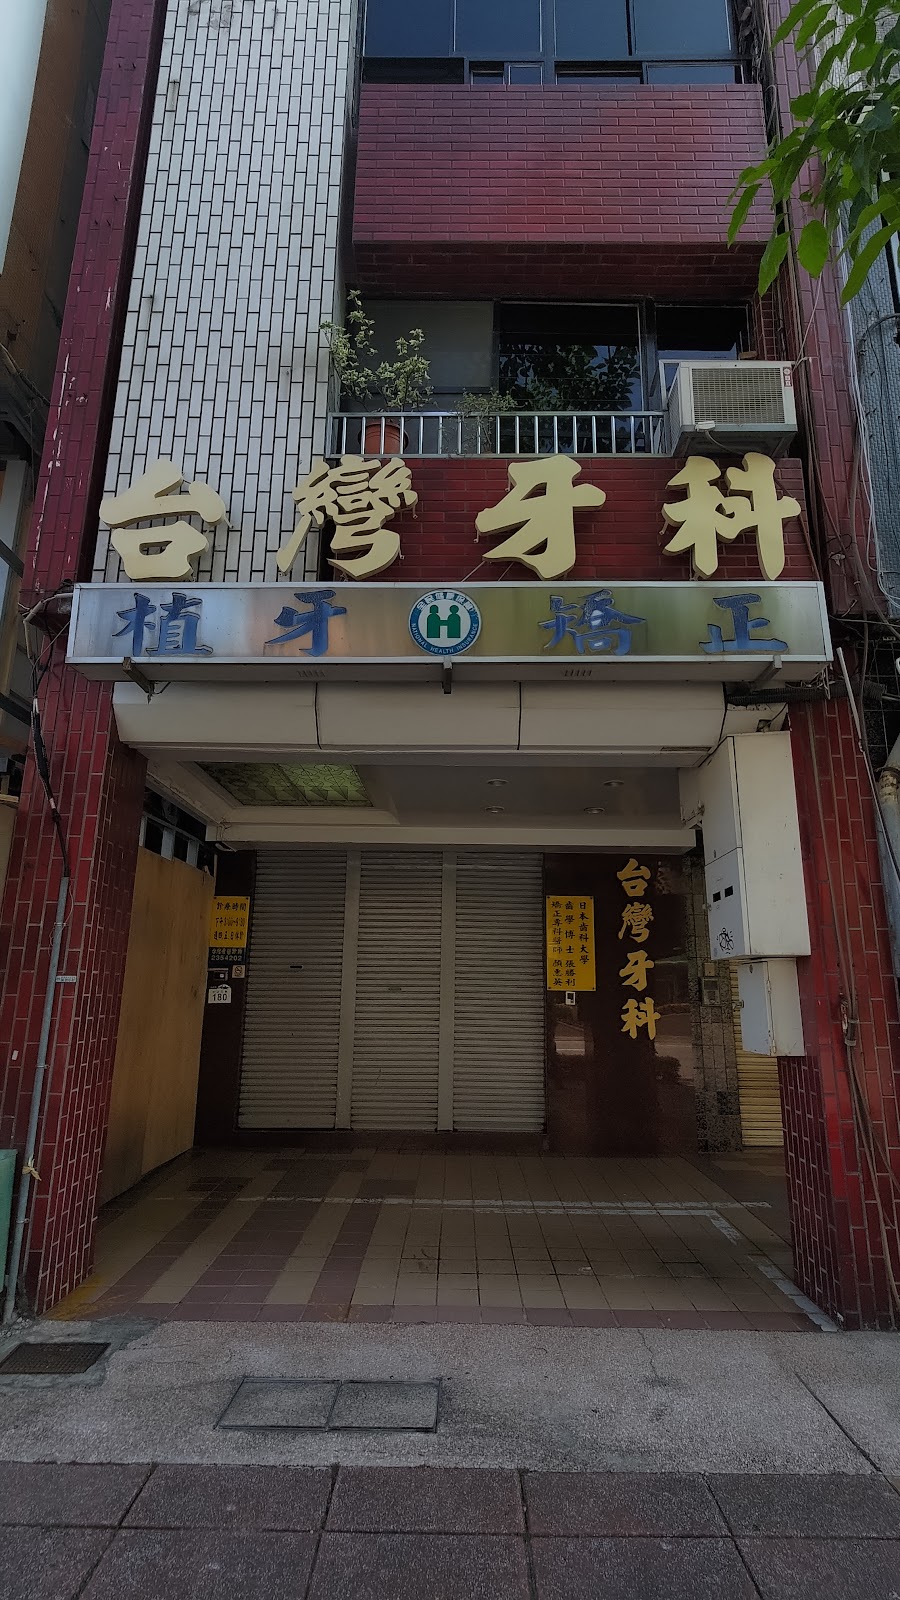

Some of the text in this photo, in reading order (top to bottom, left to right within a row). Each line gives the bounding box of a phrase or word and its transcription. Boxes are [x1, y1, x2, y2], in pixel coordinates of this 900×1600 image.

[99, 452, 802, 581] 台灣牙科
[116, 588, 787, 656] 植牙 矯正
[411, 623, 428, 648] NATIONAL
[456, 623, 479, 651] INSURANCE
[617, 858, 661, 1040] 台灣牙科
[212, 993, 227, 1002] 180
